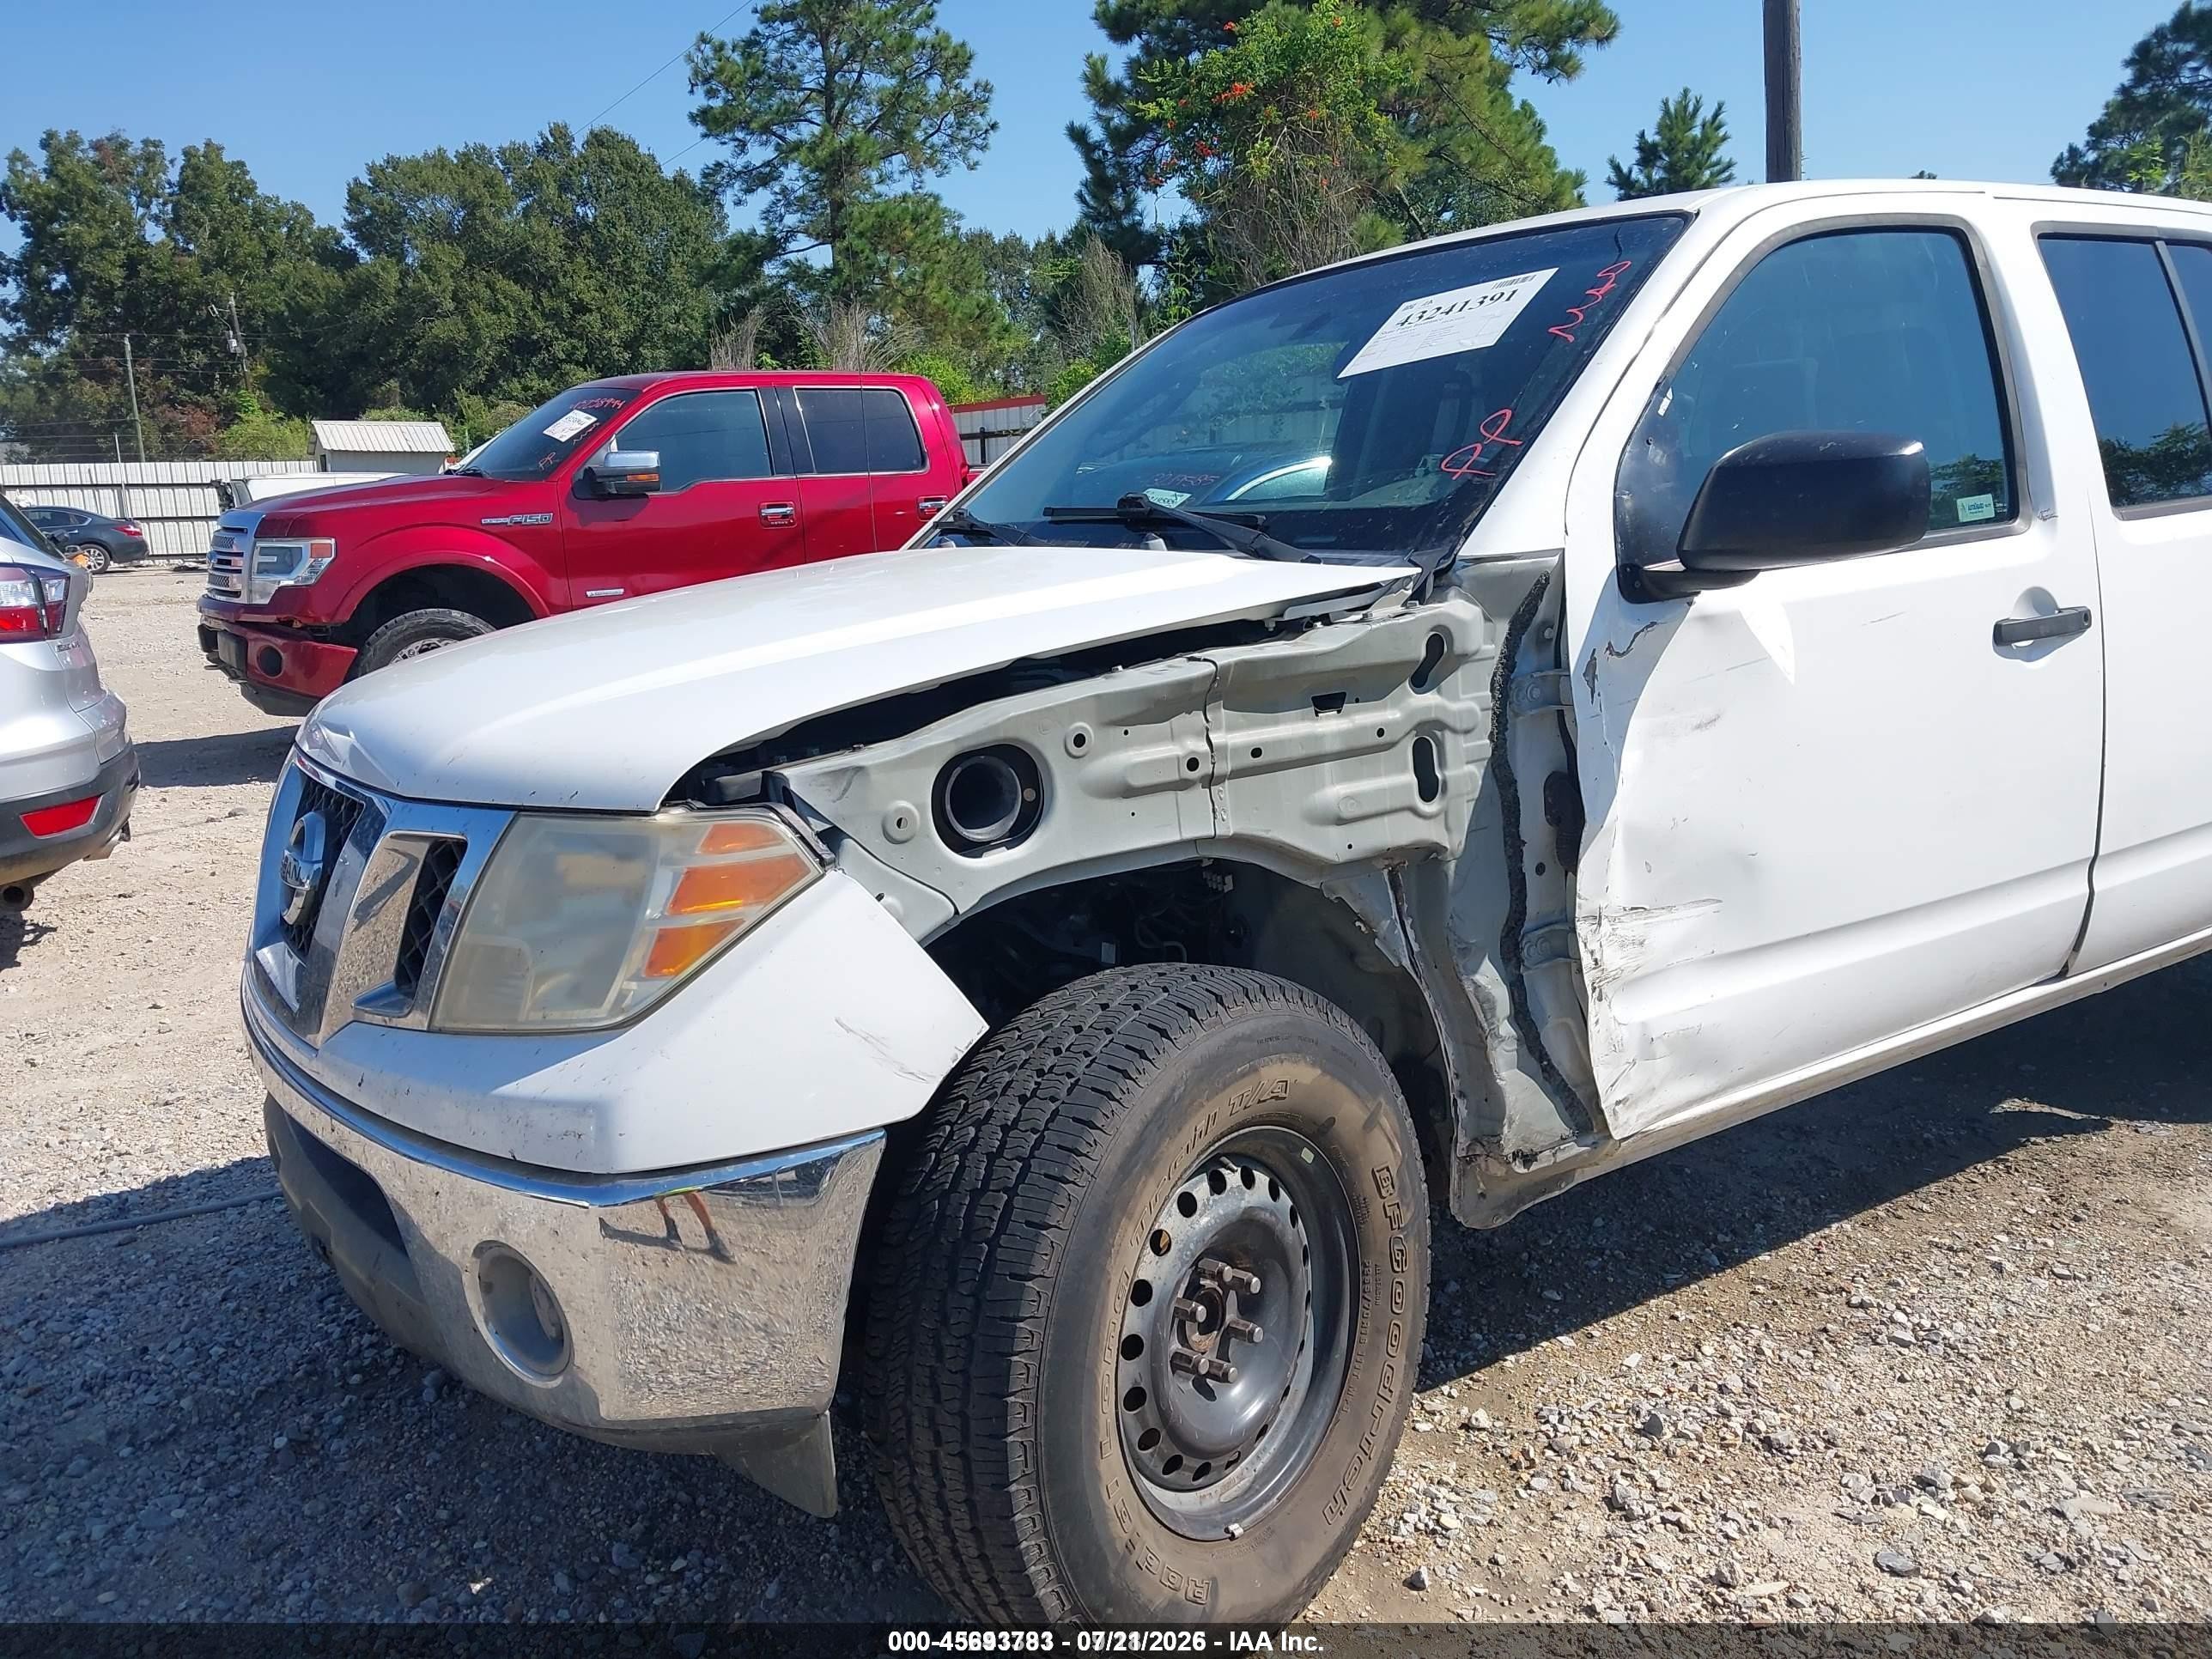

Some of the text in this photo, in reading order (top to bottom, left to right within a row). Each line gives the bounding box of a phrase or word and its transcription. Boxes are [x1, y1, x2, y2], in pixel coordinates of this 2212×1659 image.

[1395, 289, 1518, 327] 43241391
[1228, 1078, 1291, 1117] T/A
[1322, 1163, 1409, 1526] BFGoodrich
